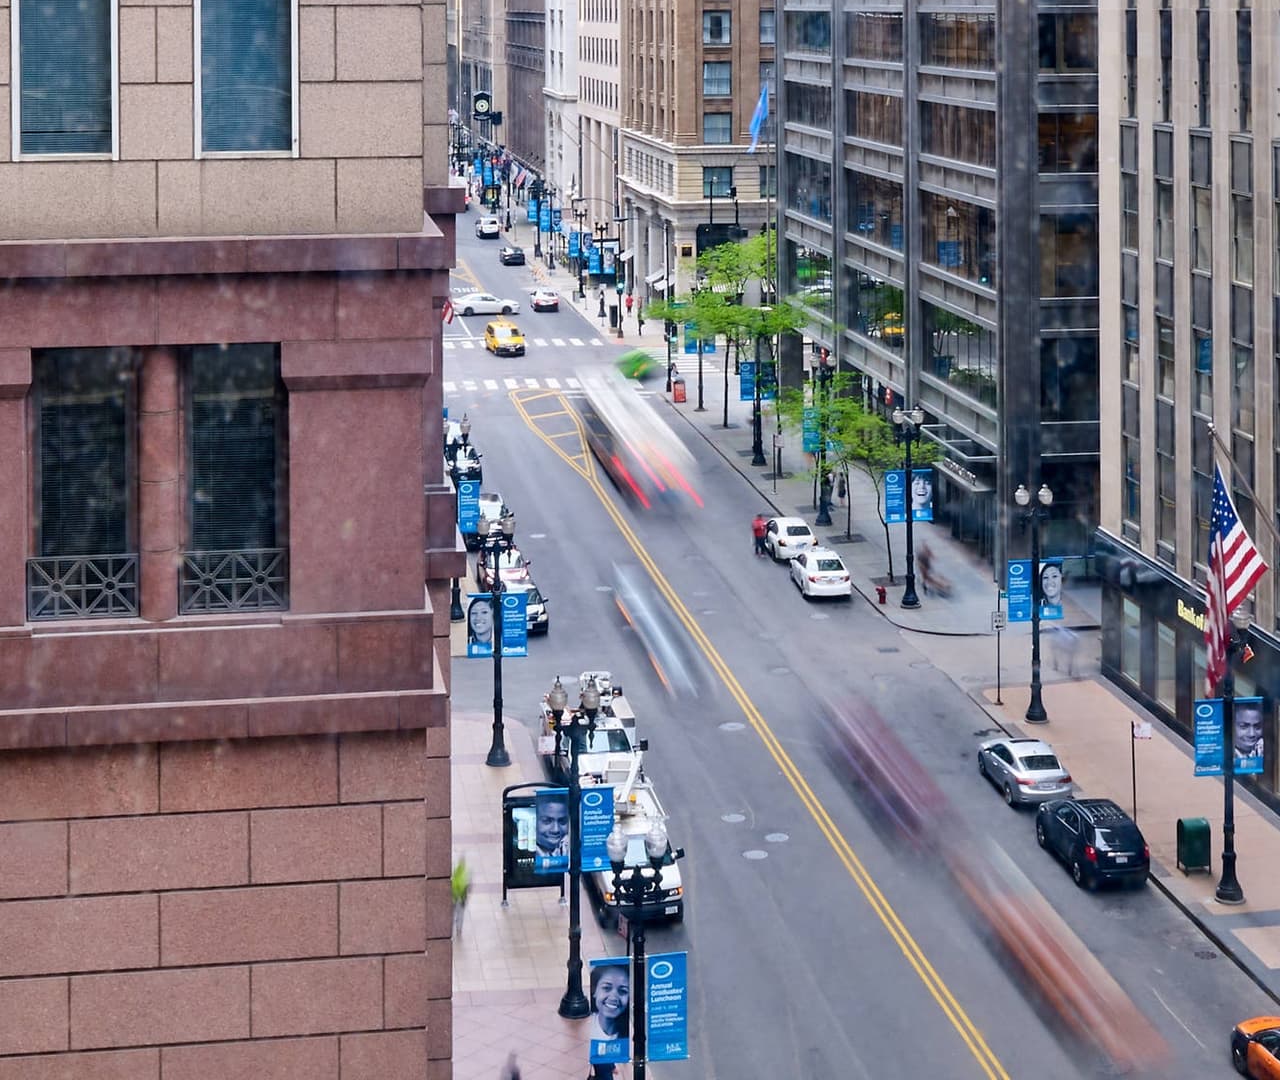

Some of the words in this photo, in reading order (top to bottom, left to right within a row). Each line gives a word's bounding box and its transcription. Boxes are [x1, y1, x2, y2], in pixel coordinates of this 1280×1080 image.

[1177, 598, 1196, 626] Bank
[1195, 613, 1204, 632] of
[650, 995, 682, 1003] Luncheon
